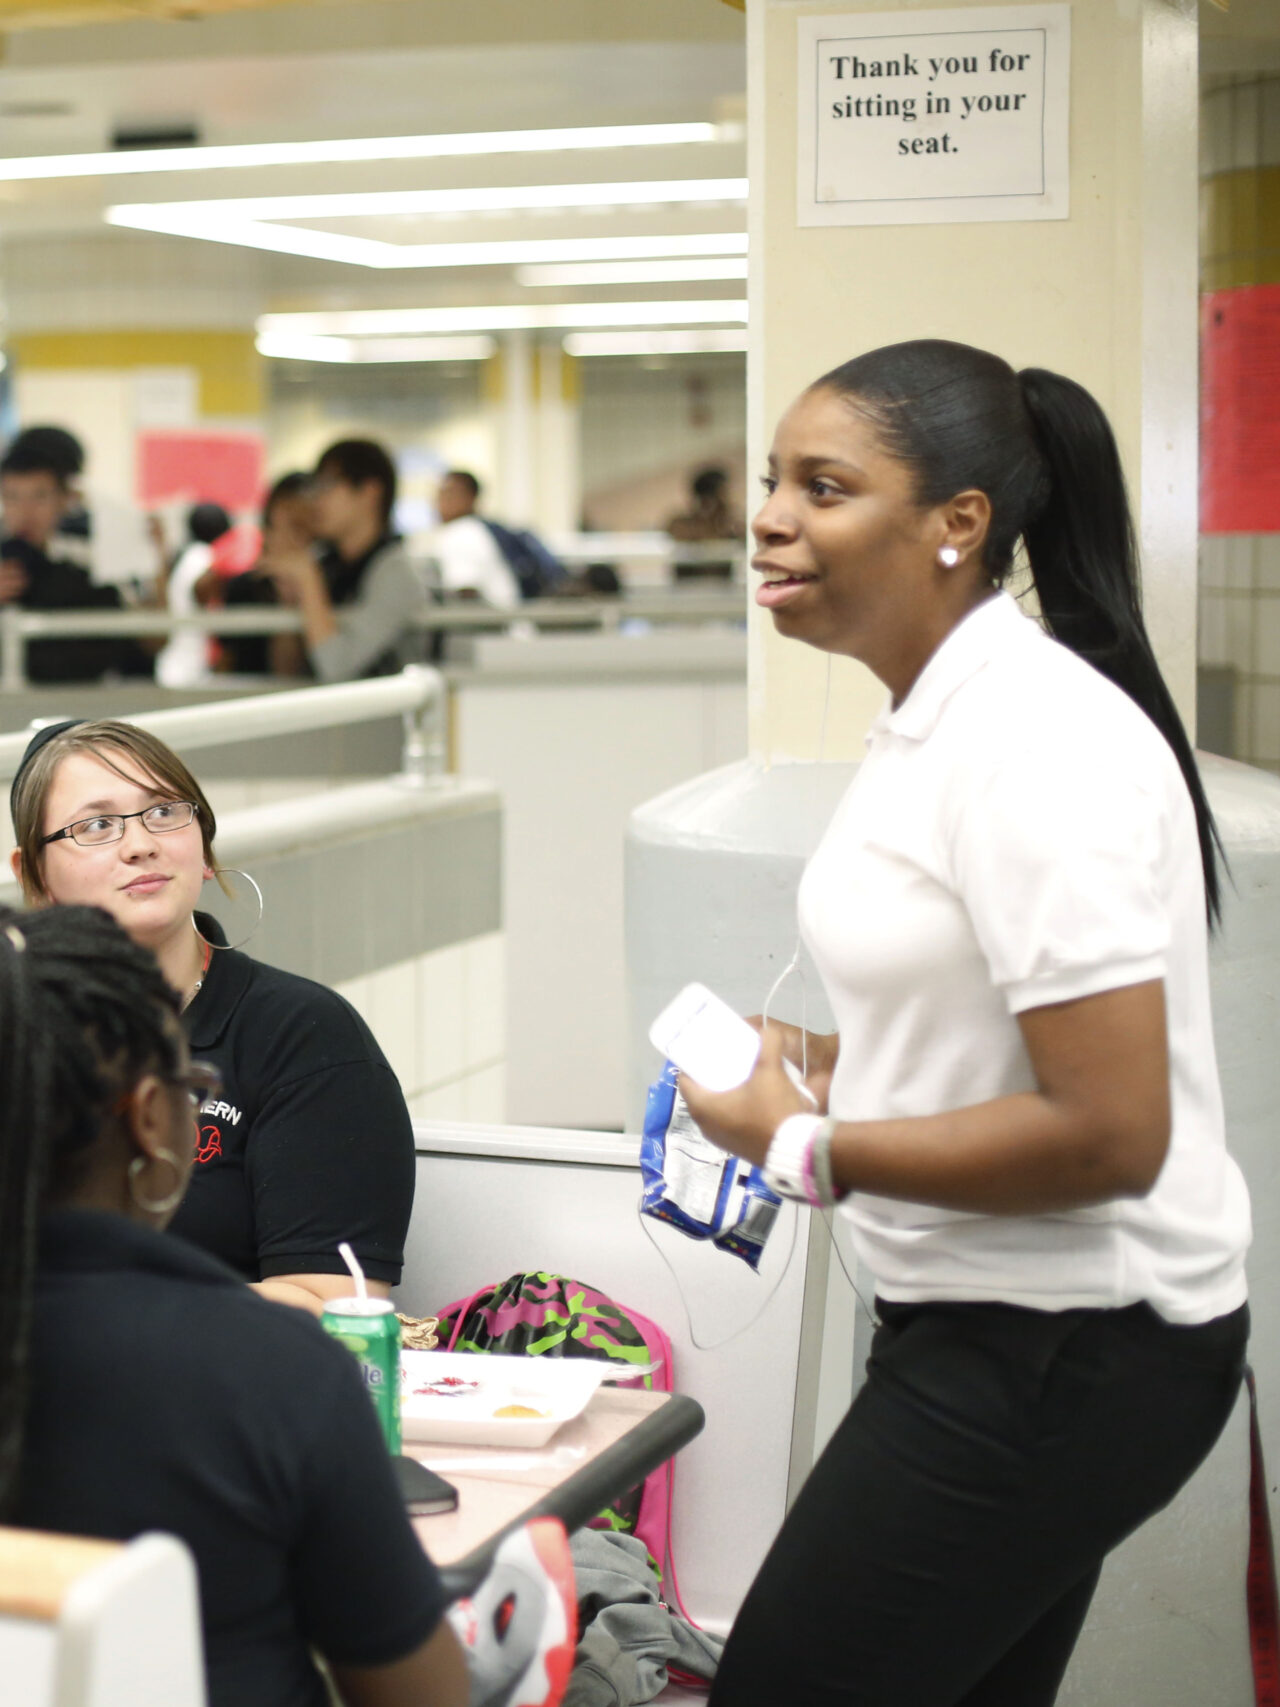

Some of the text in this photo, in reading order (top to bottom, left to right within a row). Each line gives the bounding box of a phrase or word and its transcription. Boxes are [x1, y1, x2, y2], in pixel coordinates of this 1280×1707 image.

[829, 48, 1030, 81] Thank you for
[832, 91, 1026, 122] sitting in your
[897, 133, 959, 155] seat.
